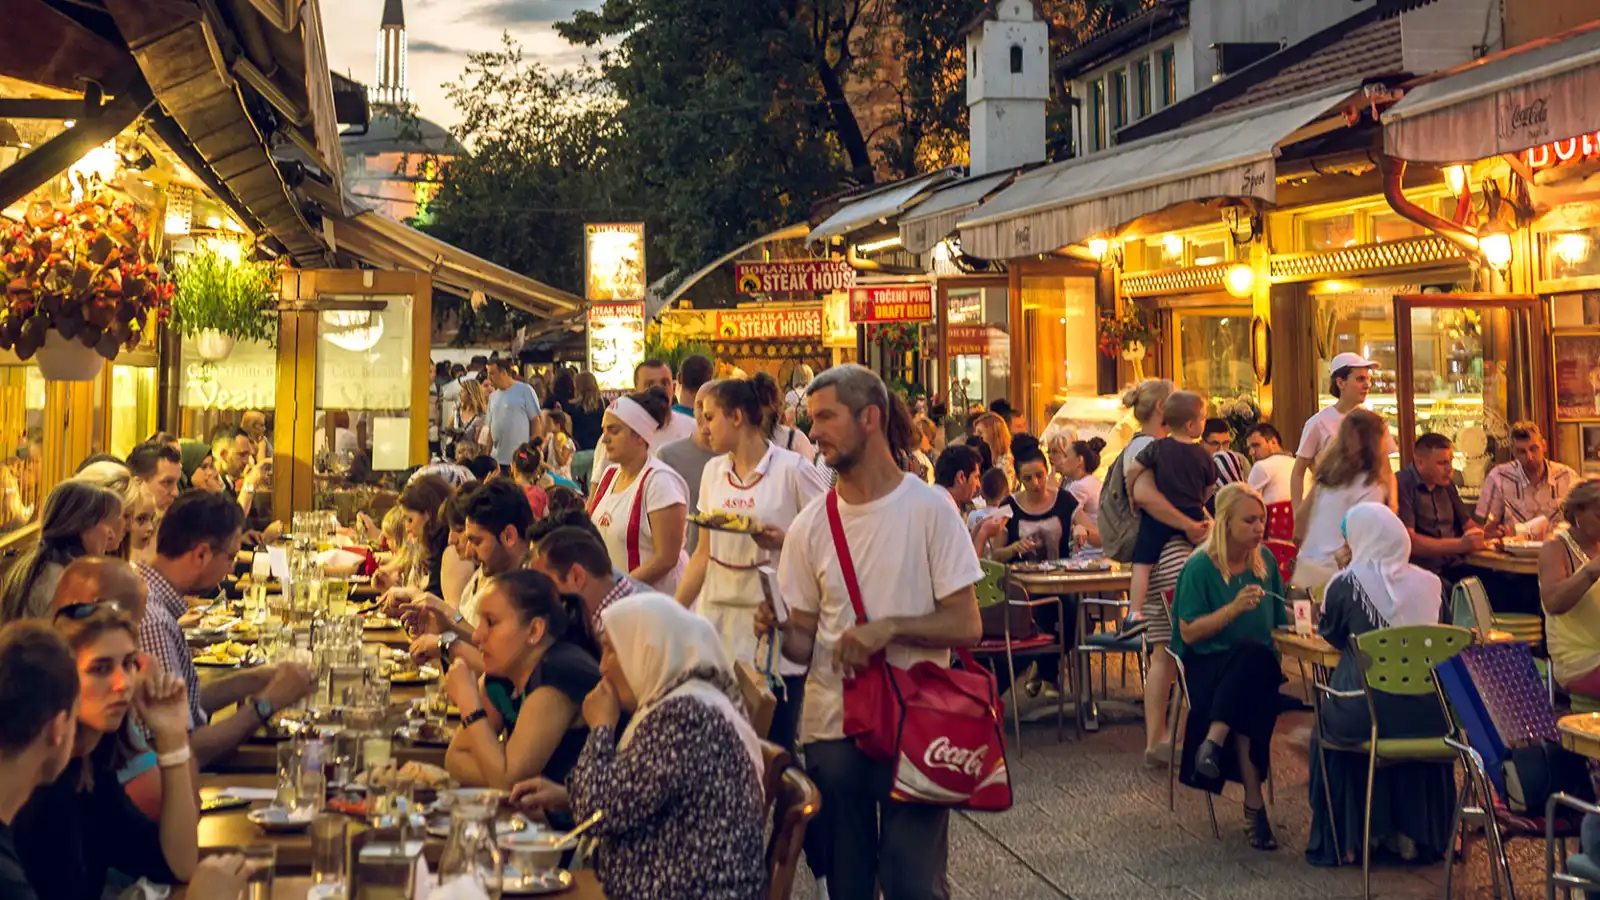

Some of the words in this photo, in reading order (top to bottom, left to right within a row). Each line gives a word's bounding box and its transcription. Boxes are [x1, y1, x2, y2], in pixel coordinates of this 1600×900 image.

[820, 261, 852, 273] KUĆ
[763, 273, 808, 291] STEAK
[874, 288, 908, 304] TOČENO
[909, 289, 930, 303] PIVO
[591, 305, 614, 315] STEAK
[616, 304, 642, 315] HOUSE
[875, 304, 905, 319] DRAFT
[907, 303, 930, 318] BEER
[739, 320, 777, 338] STEAK
[780, 319, 821, 336] HOUSE
